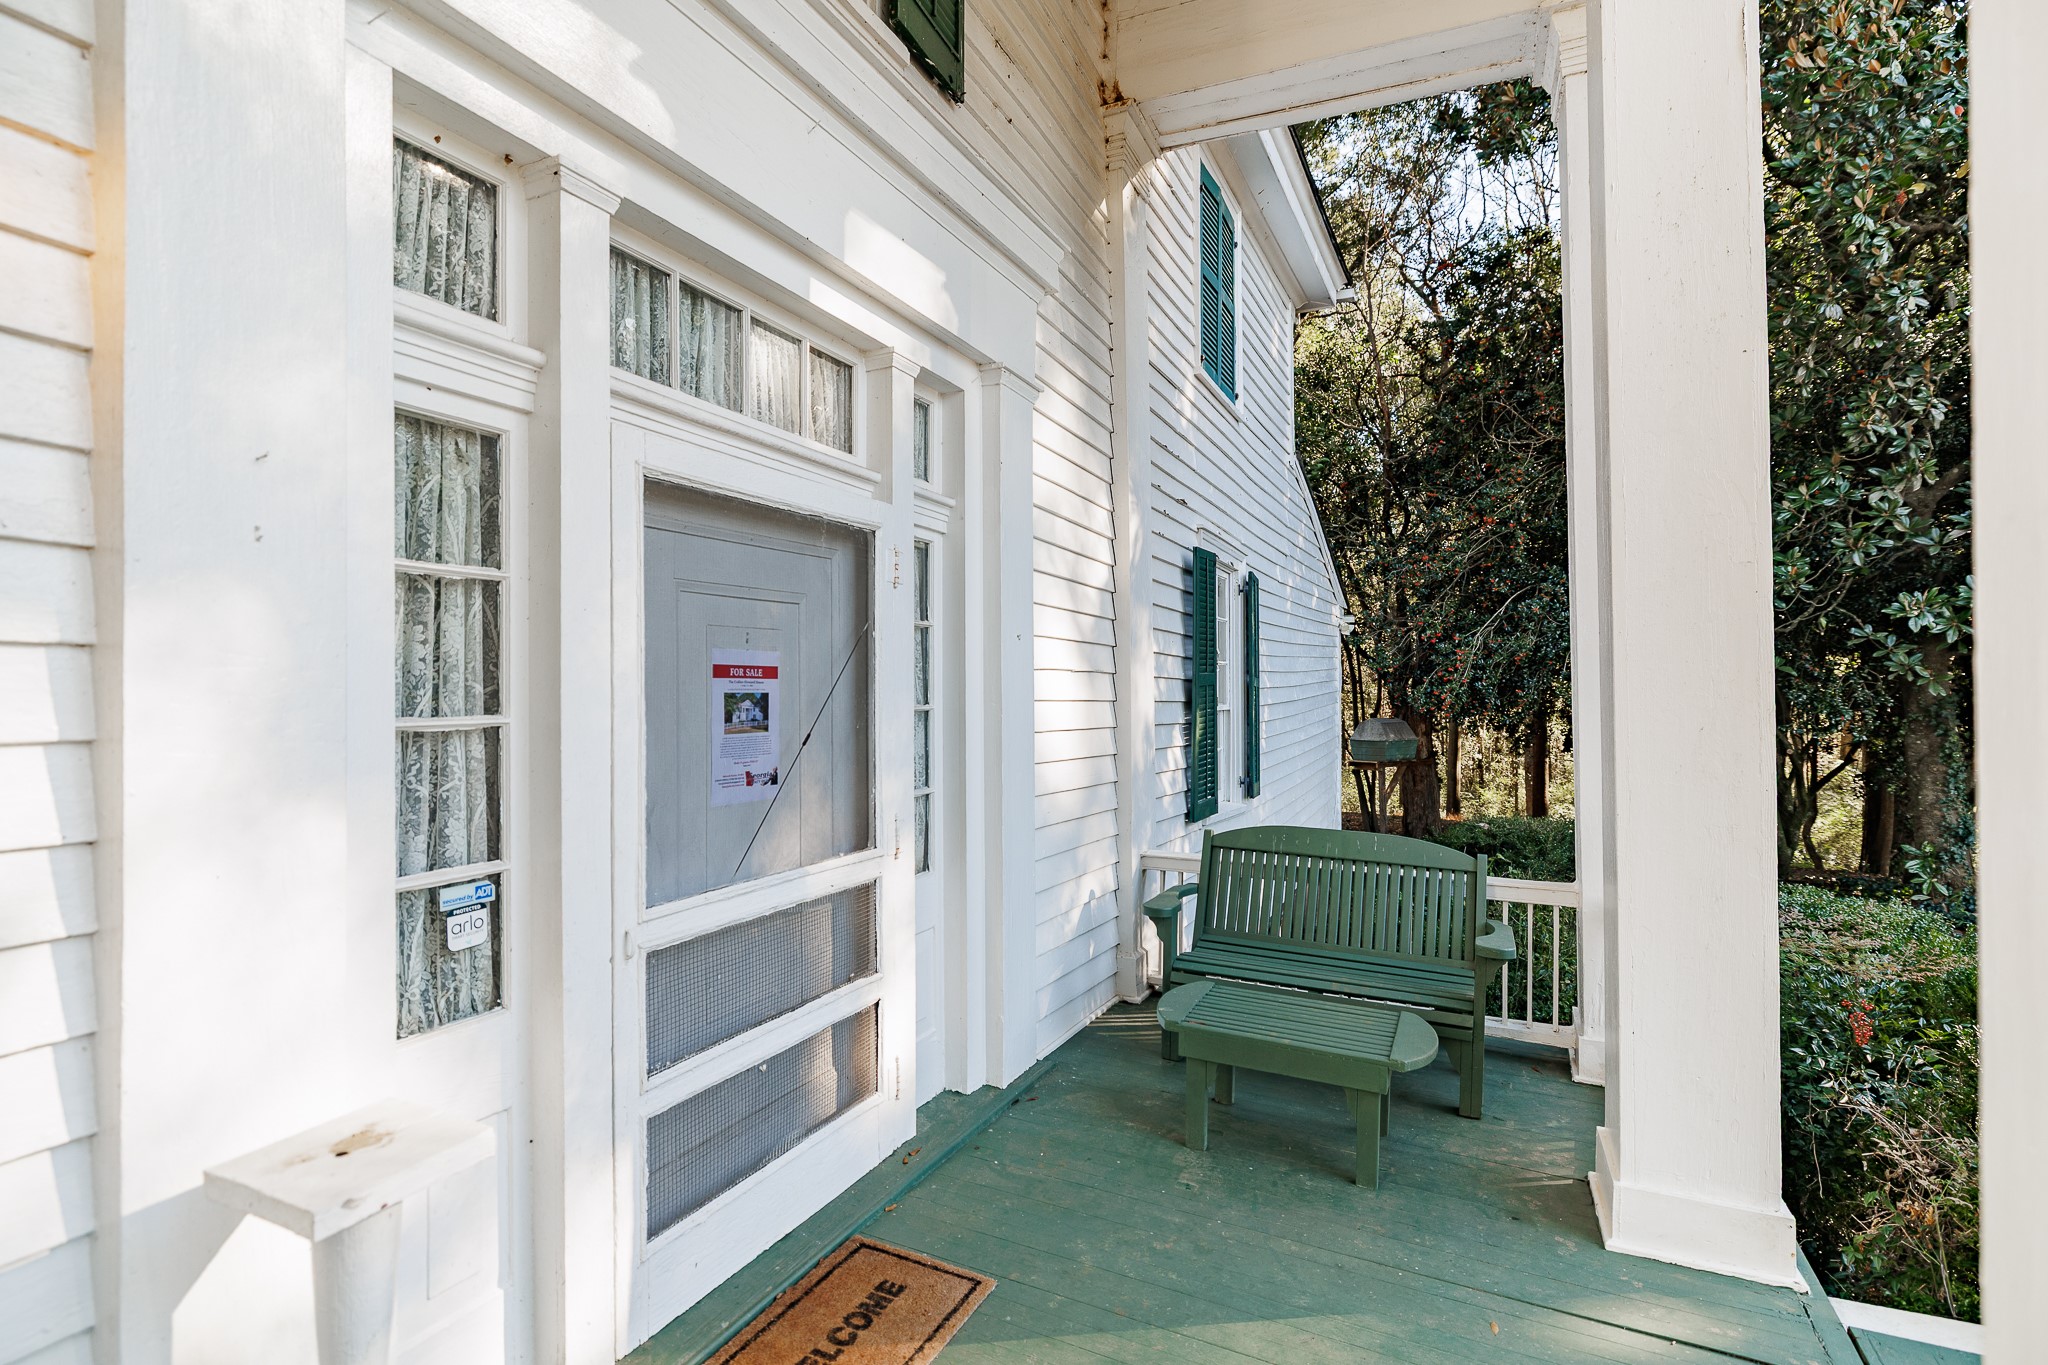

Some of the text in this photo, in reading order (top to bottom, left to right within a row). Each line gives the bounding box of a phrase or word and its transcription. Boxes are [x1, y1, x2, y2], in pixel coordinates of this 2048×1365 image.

[730, 668, 762, 676] FOR SALE
[442, 896, 466, 904] secured
[476, 886, 492, 899] ADT
[453, 904, 481, 915] PROTECTED
[451, 914, 484, 935] arlo
